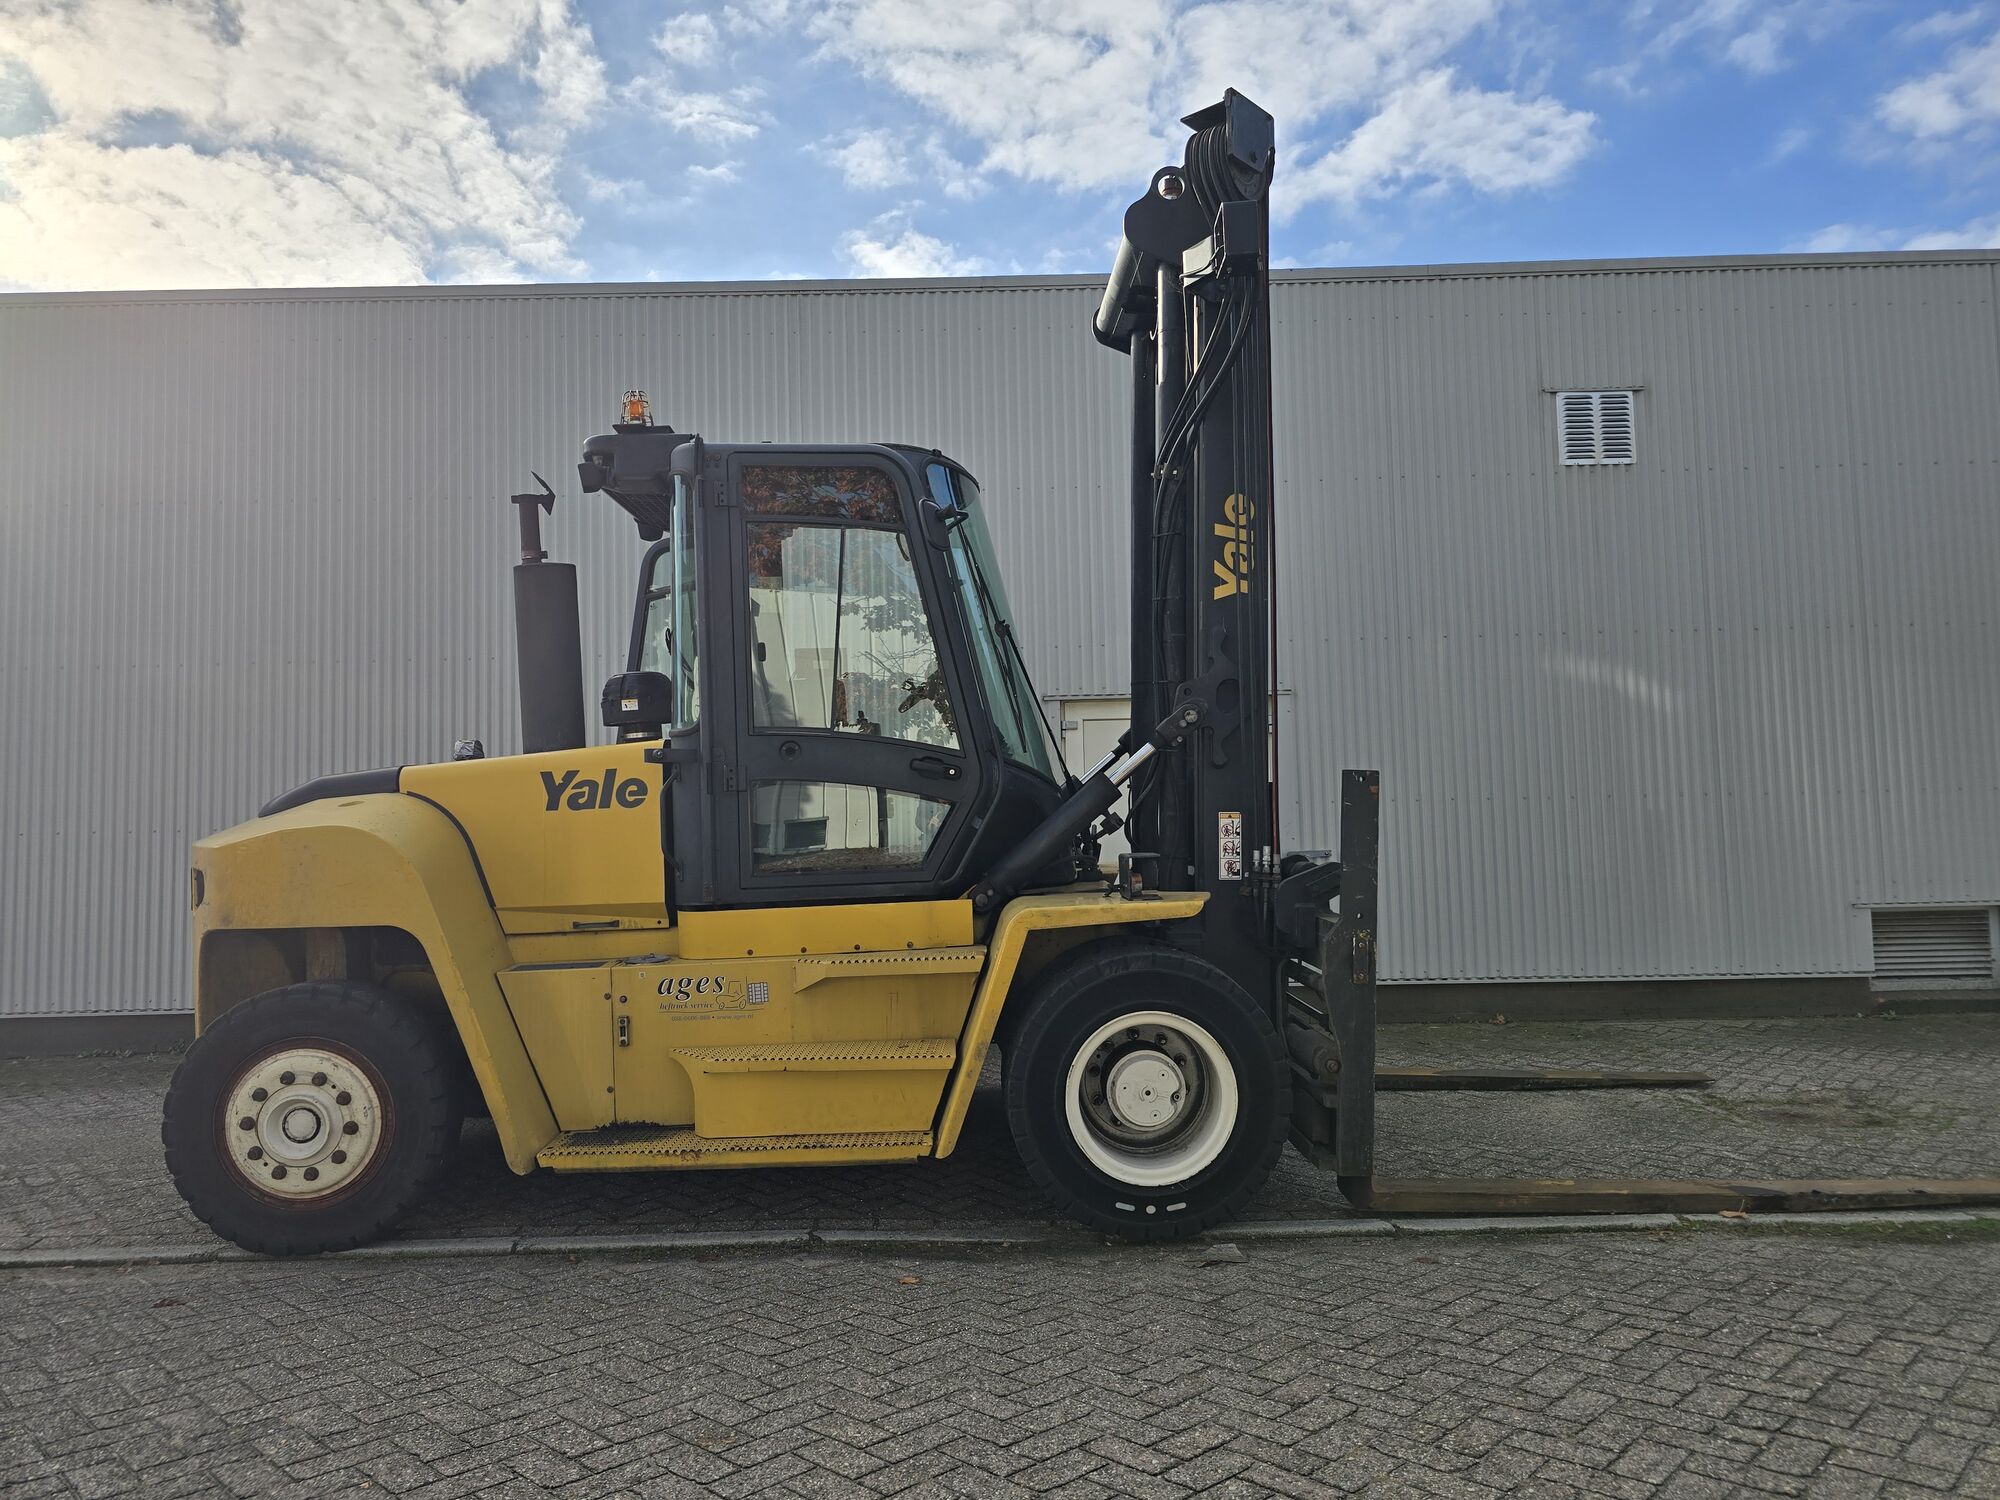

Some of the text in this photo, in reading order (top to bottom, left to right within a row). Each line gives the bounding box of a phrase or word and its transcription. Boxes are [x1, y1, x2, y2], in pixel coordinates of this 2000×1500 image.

[1213, 493, 1255, 600] Yale
[540, 768, 648, 811] Yale
[657, 975, 725, 1002] ages
